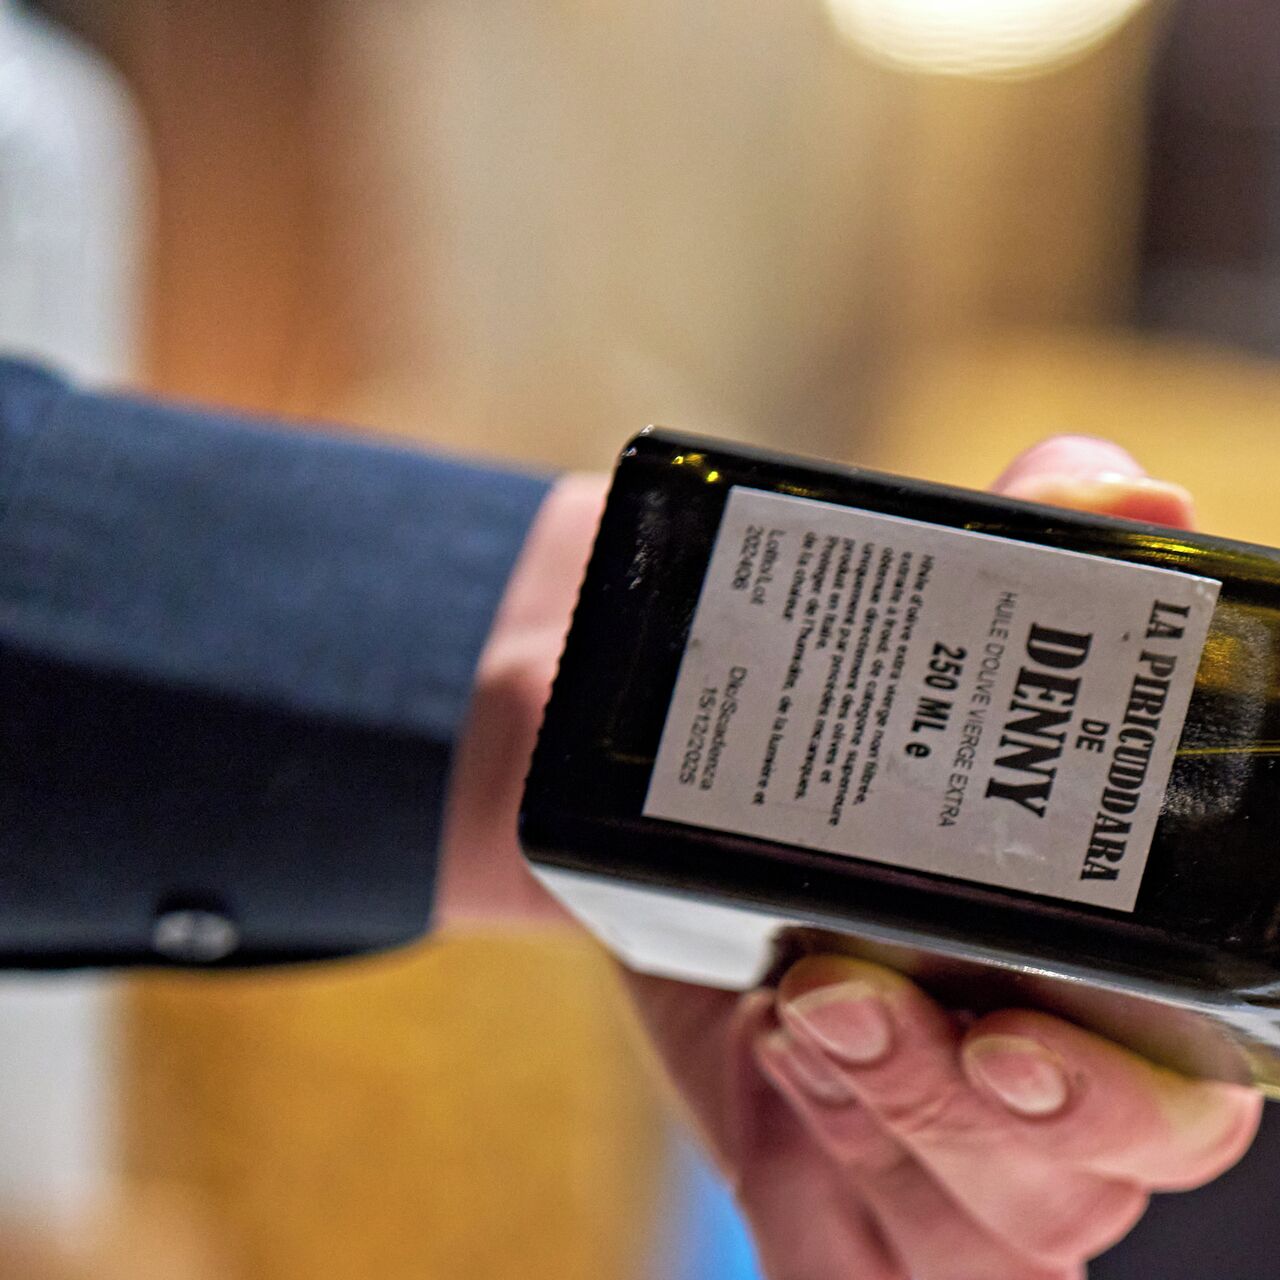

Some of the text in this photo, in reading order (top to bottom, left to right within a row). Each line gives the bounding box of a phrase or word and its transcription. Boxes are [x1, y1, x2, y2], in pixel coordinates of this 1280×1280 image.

[801, 531, 819, 551] de
[796, 551, 814, 568] la
[843, 543, 874, 625] uniquement
[804, 597, 820, 618] de
[827, 592, 841, 611] en
[835, 627, 852, 654] par
[819, 546, 894, 785] obtenue directement des olives et
[868, 658, 885, 679] de
[888, 644, 909, 681] extra
[924, 642, 967, 691] 250
[777, 695, 793, 715] de
[875, 683, 897, 728] vierge
[911, 697, 953, 732] ML
[938, 592, 1018, 827] HUILE D'OLIVE VIERGE EXTRA
[984, 622, 1093, 818] DENNY
[771, 716, 789, 733] la
[1075, 718, 1110, 753] DE
[1080, 600, 1190, 881] LA PIRICUDDARA
[867, 729, 885, 759] non
[751, 790, 766, 806] et
